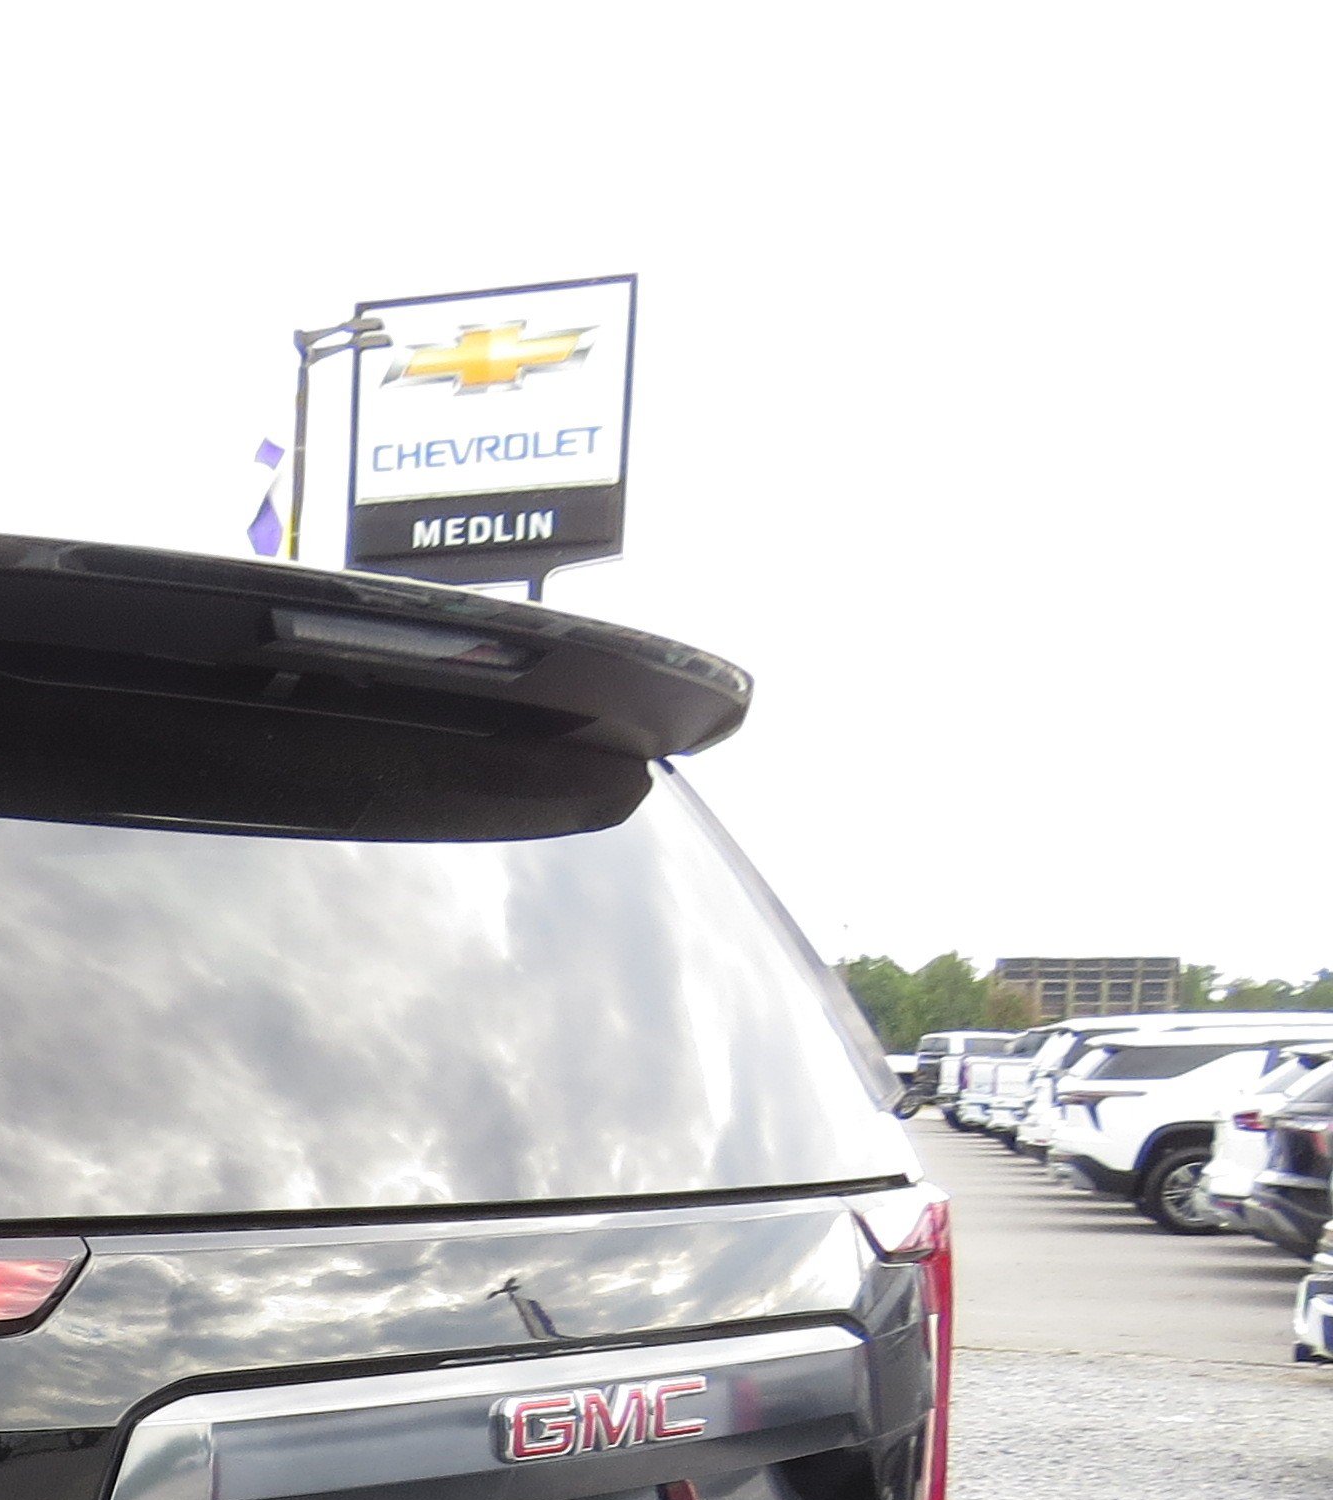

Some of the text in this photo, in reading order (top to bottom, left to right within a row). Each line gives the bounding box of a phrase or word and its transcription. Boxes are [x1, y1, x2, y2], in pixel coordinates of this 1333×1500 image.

[372, 425, 603, 472] CHEVROLET
[412, 509, 554, 549] MEDLIN
[489, 1373, 708, 1463] GMC
